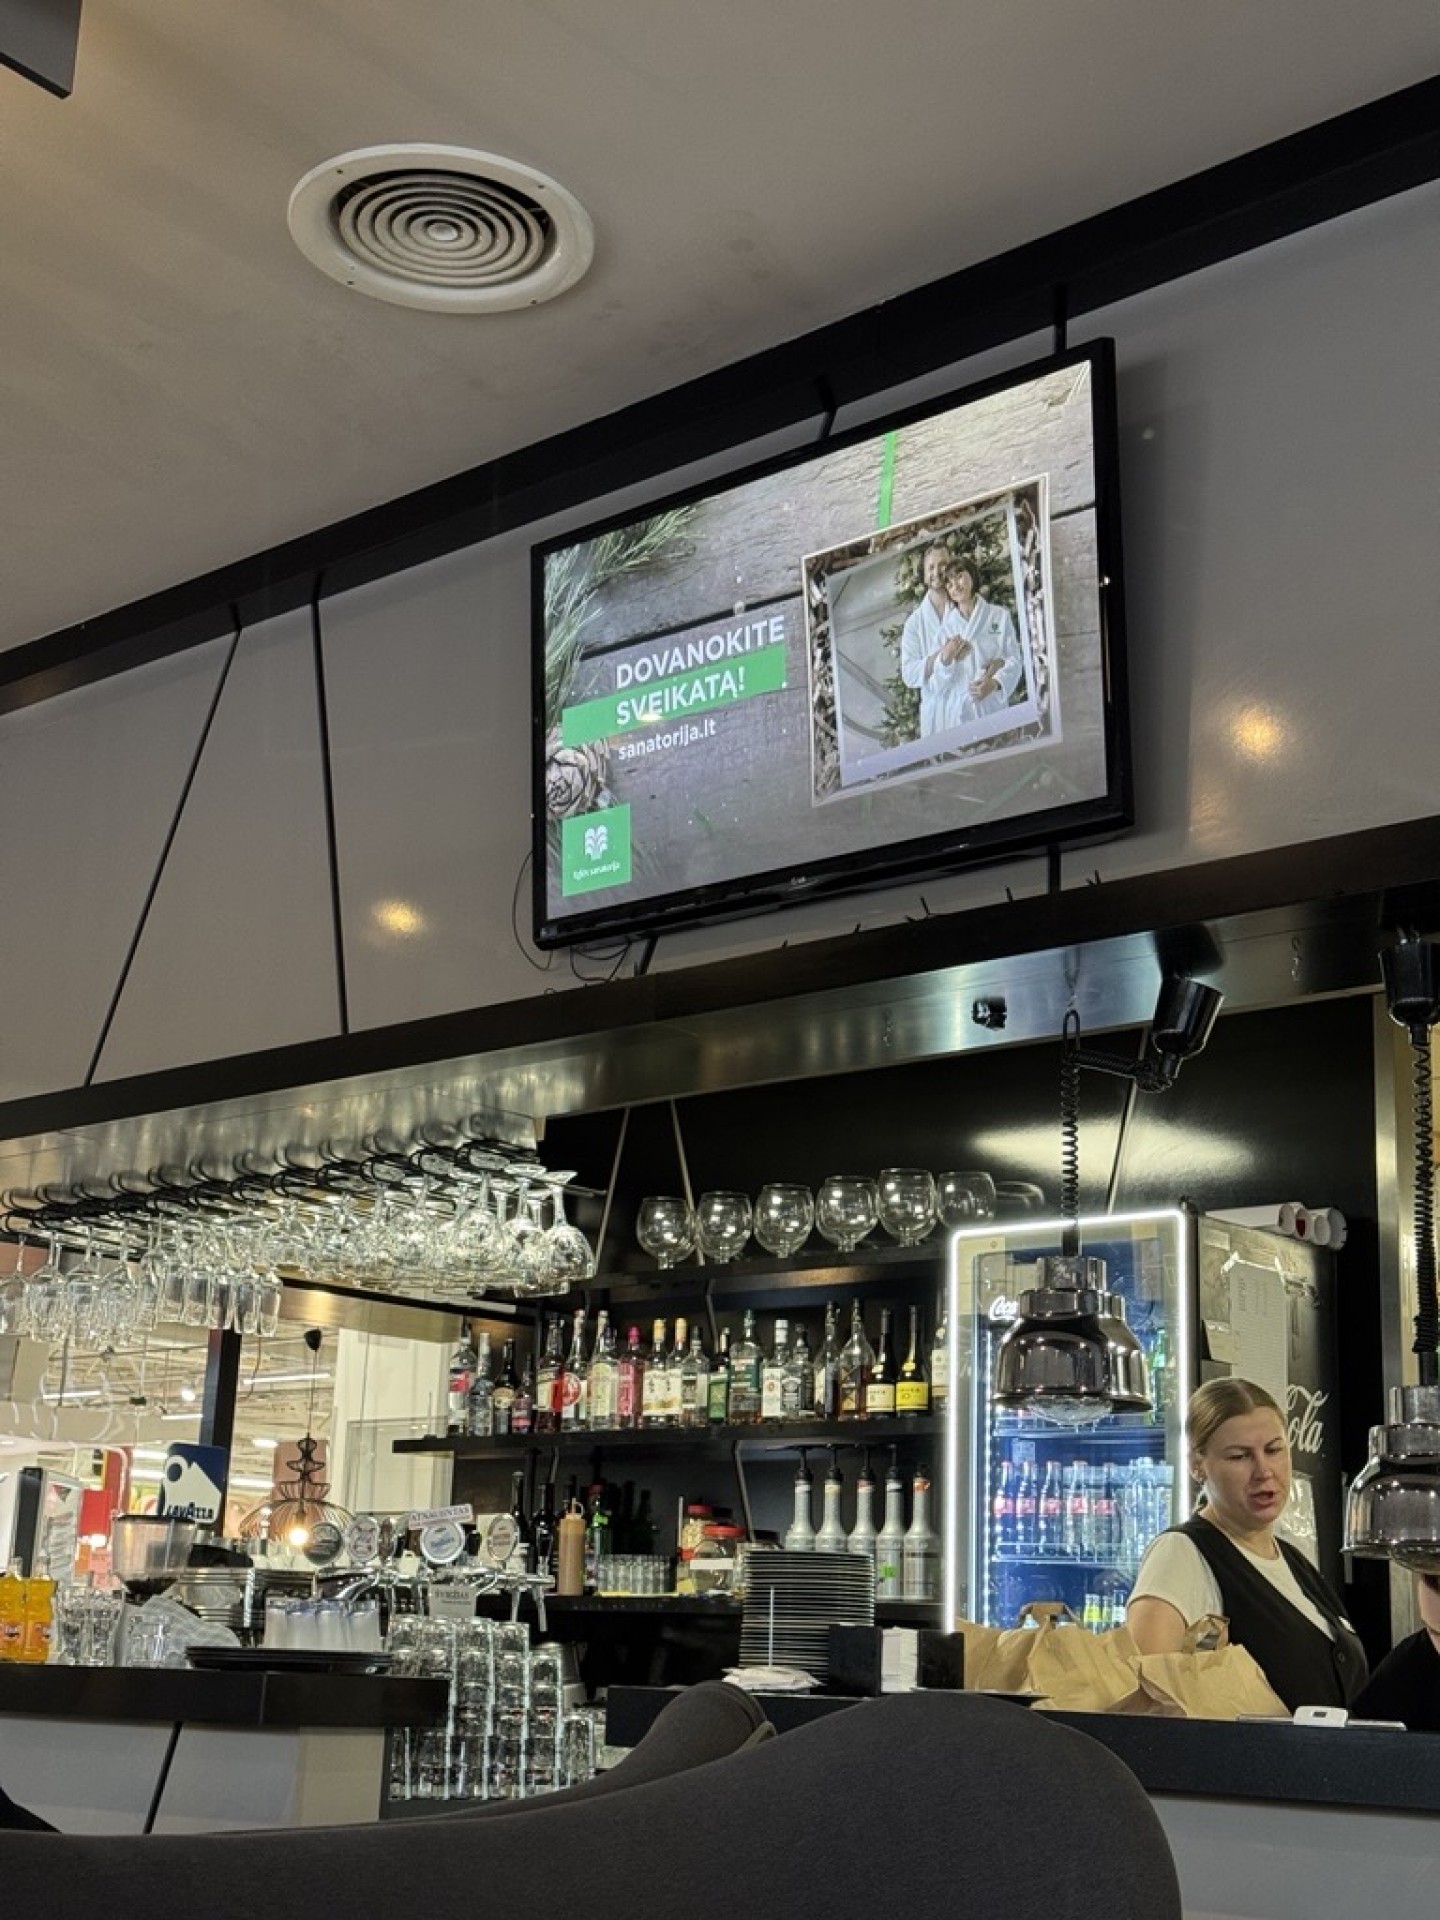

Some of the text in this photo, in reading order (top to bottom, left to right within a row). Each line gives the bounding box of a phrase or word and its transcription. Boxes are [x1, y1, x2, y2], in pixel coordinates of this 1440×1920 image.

[616, 614, 785, 689] DOVANOKITE
[616, 666, 745, 725] SVEIKATĄ!
[618, 719, 717, 760] sanatorija.lt
[167, 1501, 214, 1519] LAVAZZA
